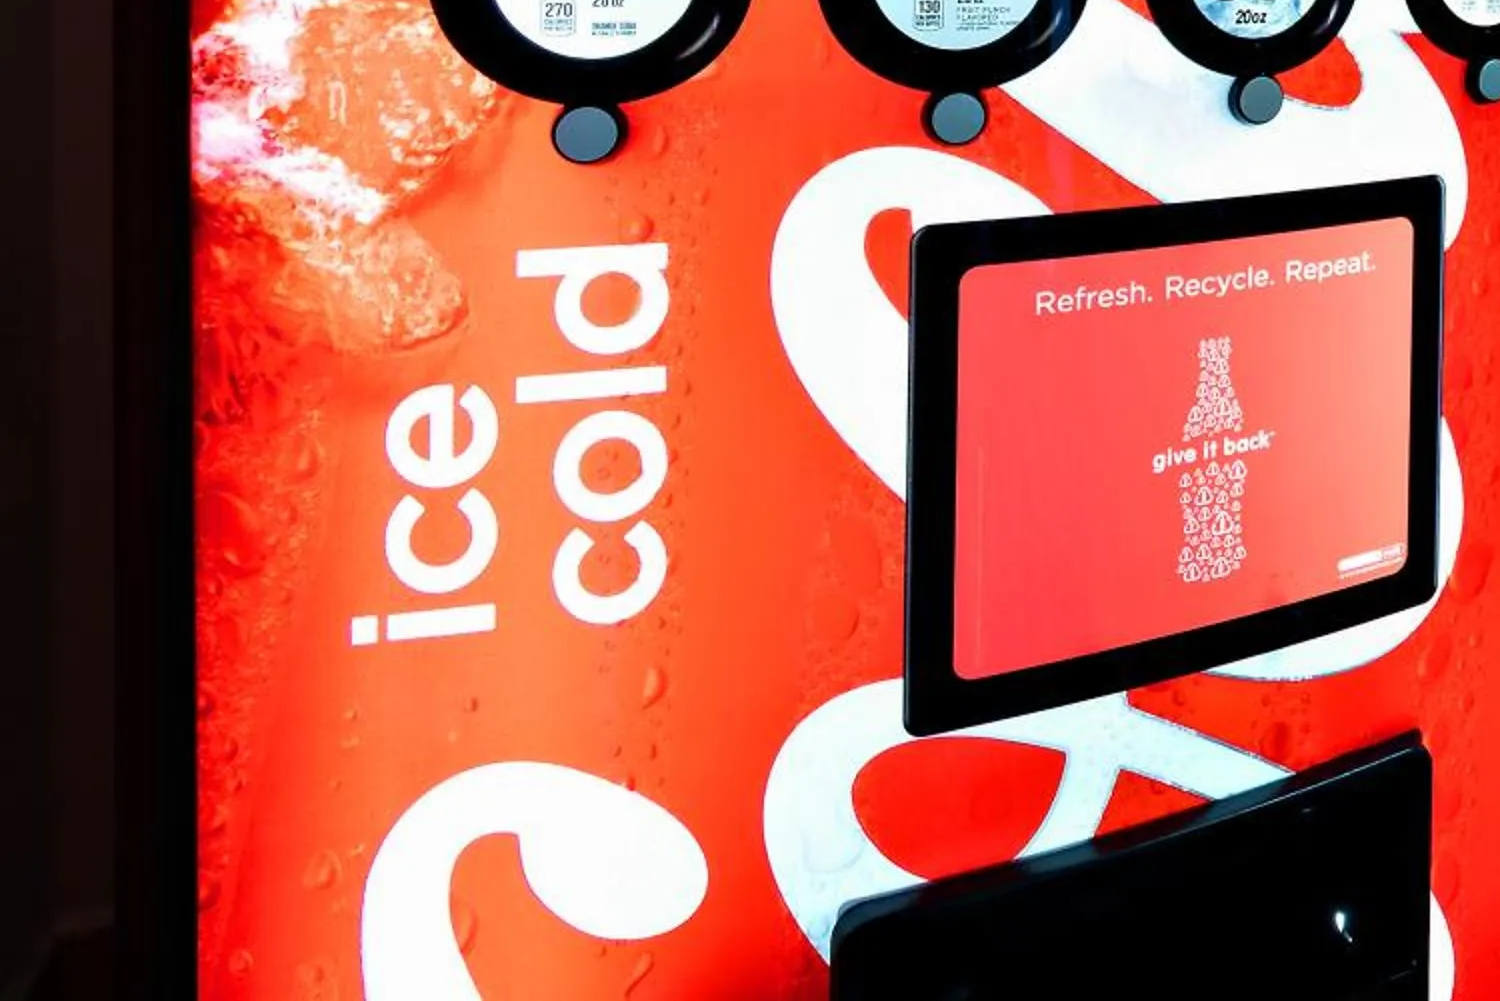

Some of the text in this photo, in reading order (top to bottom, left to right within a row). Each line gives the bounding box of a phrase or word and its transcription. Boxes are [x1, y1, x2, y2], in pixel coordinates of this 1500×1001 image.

[545, 2, 573, 18] 270
[919, 0, 941, 14] 130
[1235, 9, 1268, 24] 20oz
[1034, 250, 1376, 316] Refresh. Recycle. Repeat.
[515, 242, 670, 625] cold
[1152, 430, 1270, 474] give it back
[351, 383, 499, 646] ice
